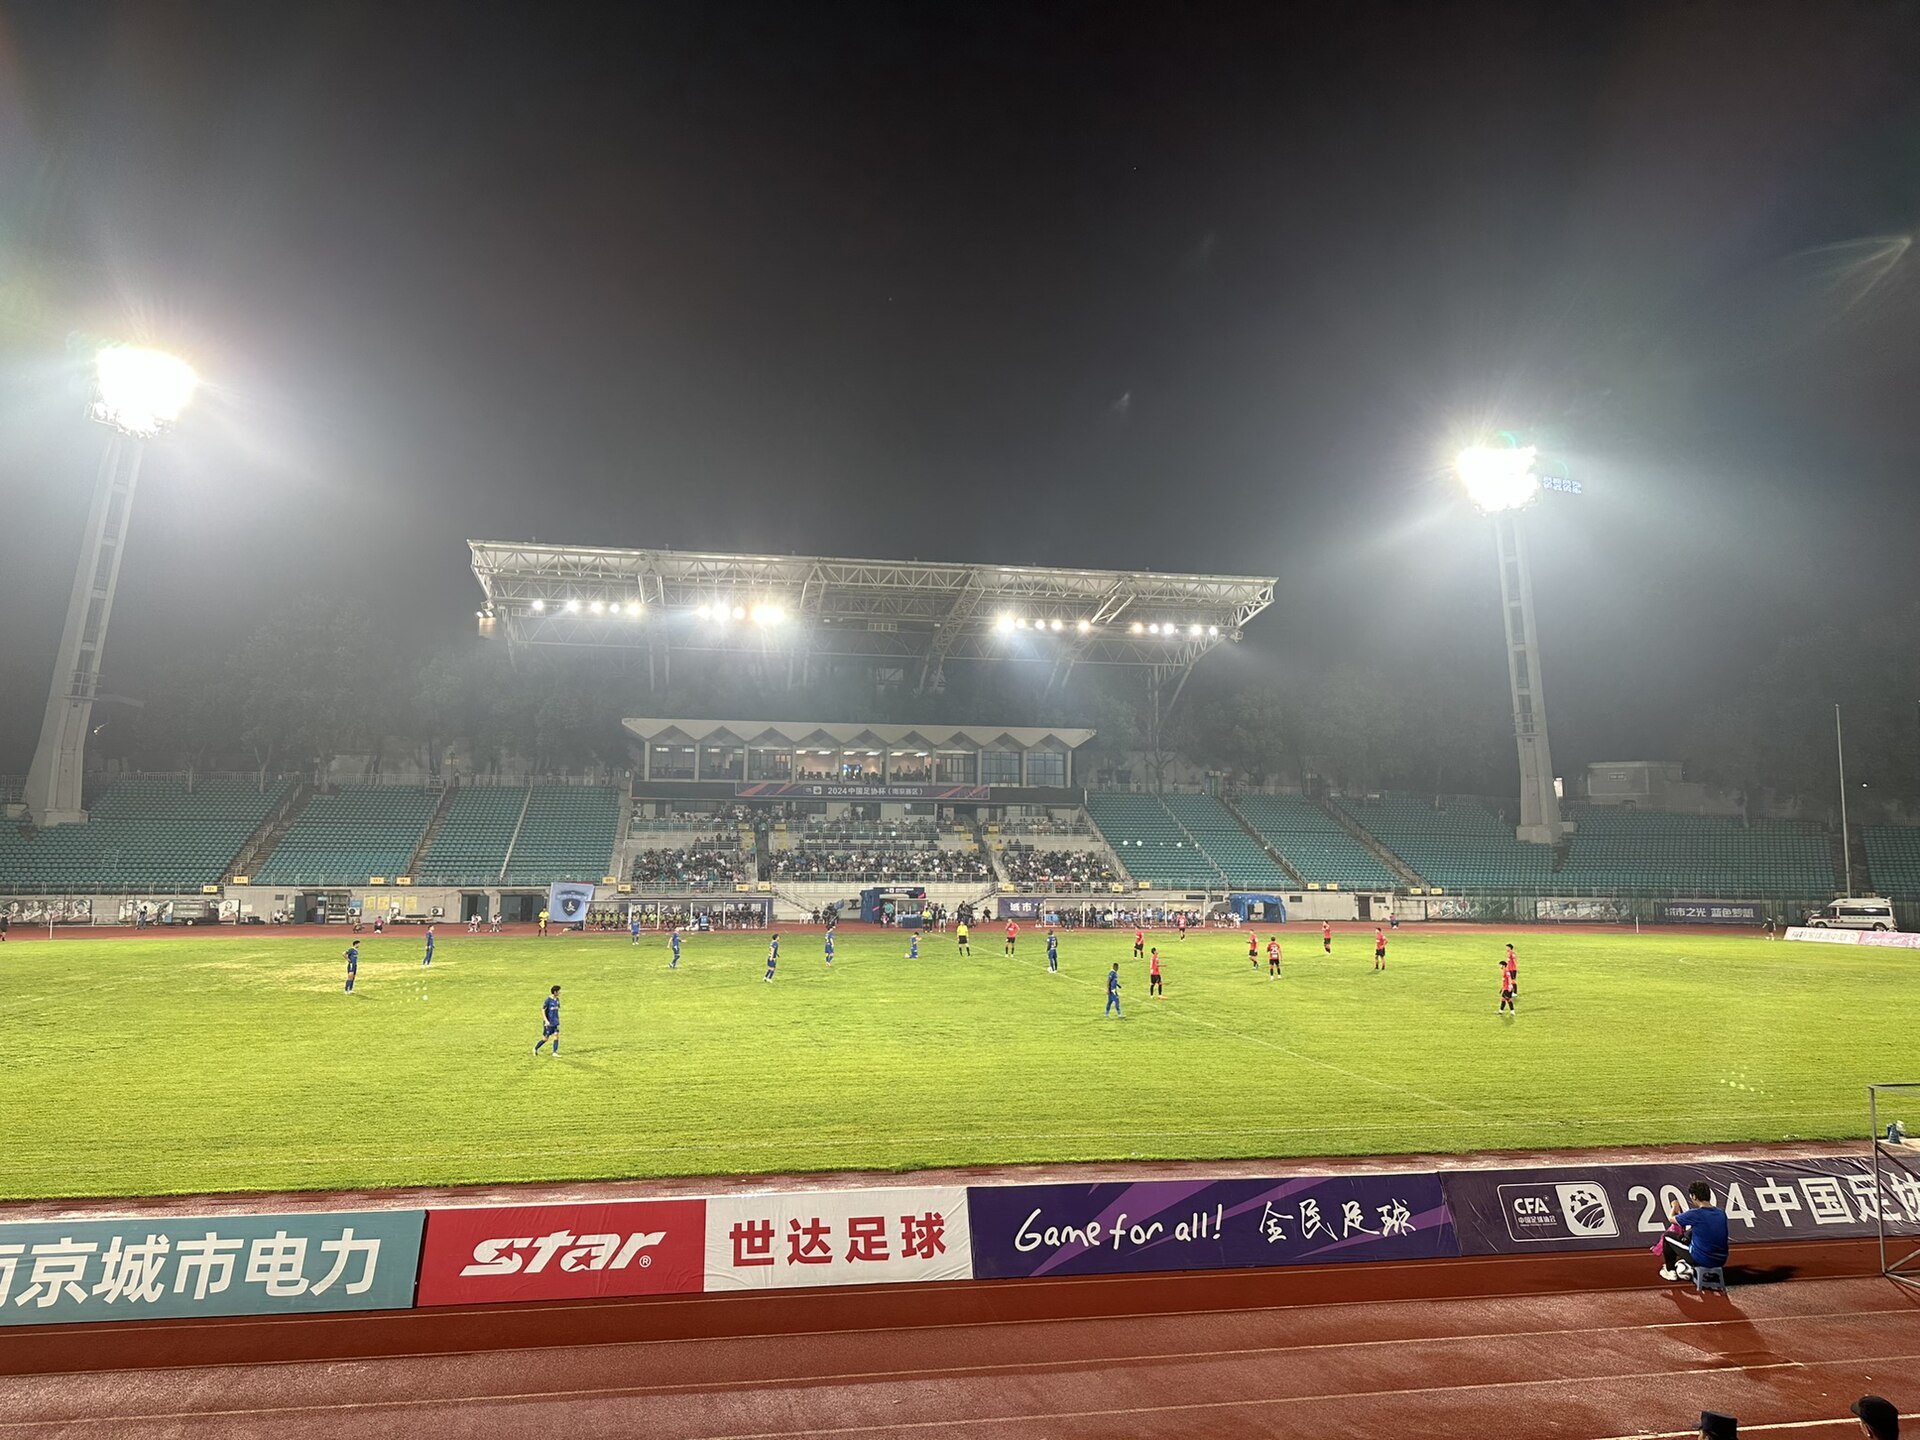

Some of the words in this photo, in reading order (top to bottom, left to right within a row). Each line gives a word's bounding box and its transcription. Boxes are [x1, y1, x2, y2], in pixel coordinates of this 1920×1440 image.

[1014, 1208, 1101, 1251] Game
[1109, 1213, 1163, 1250] for
[1174, 1203, 1223, 1242] all!
[1259, 1198, 1416, 1244] 全民足球
[1513, 1197, 1551, 1214] CFA
[729, 1211, 947, 1267] 世达足球
